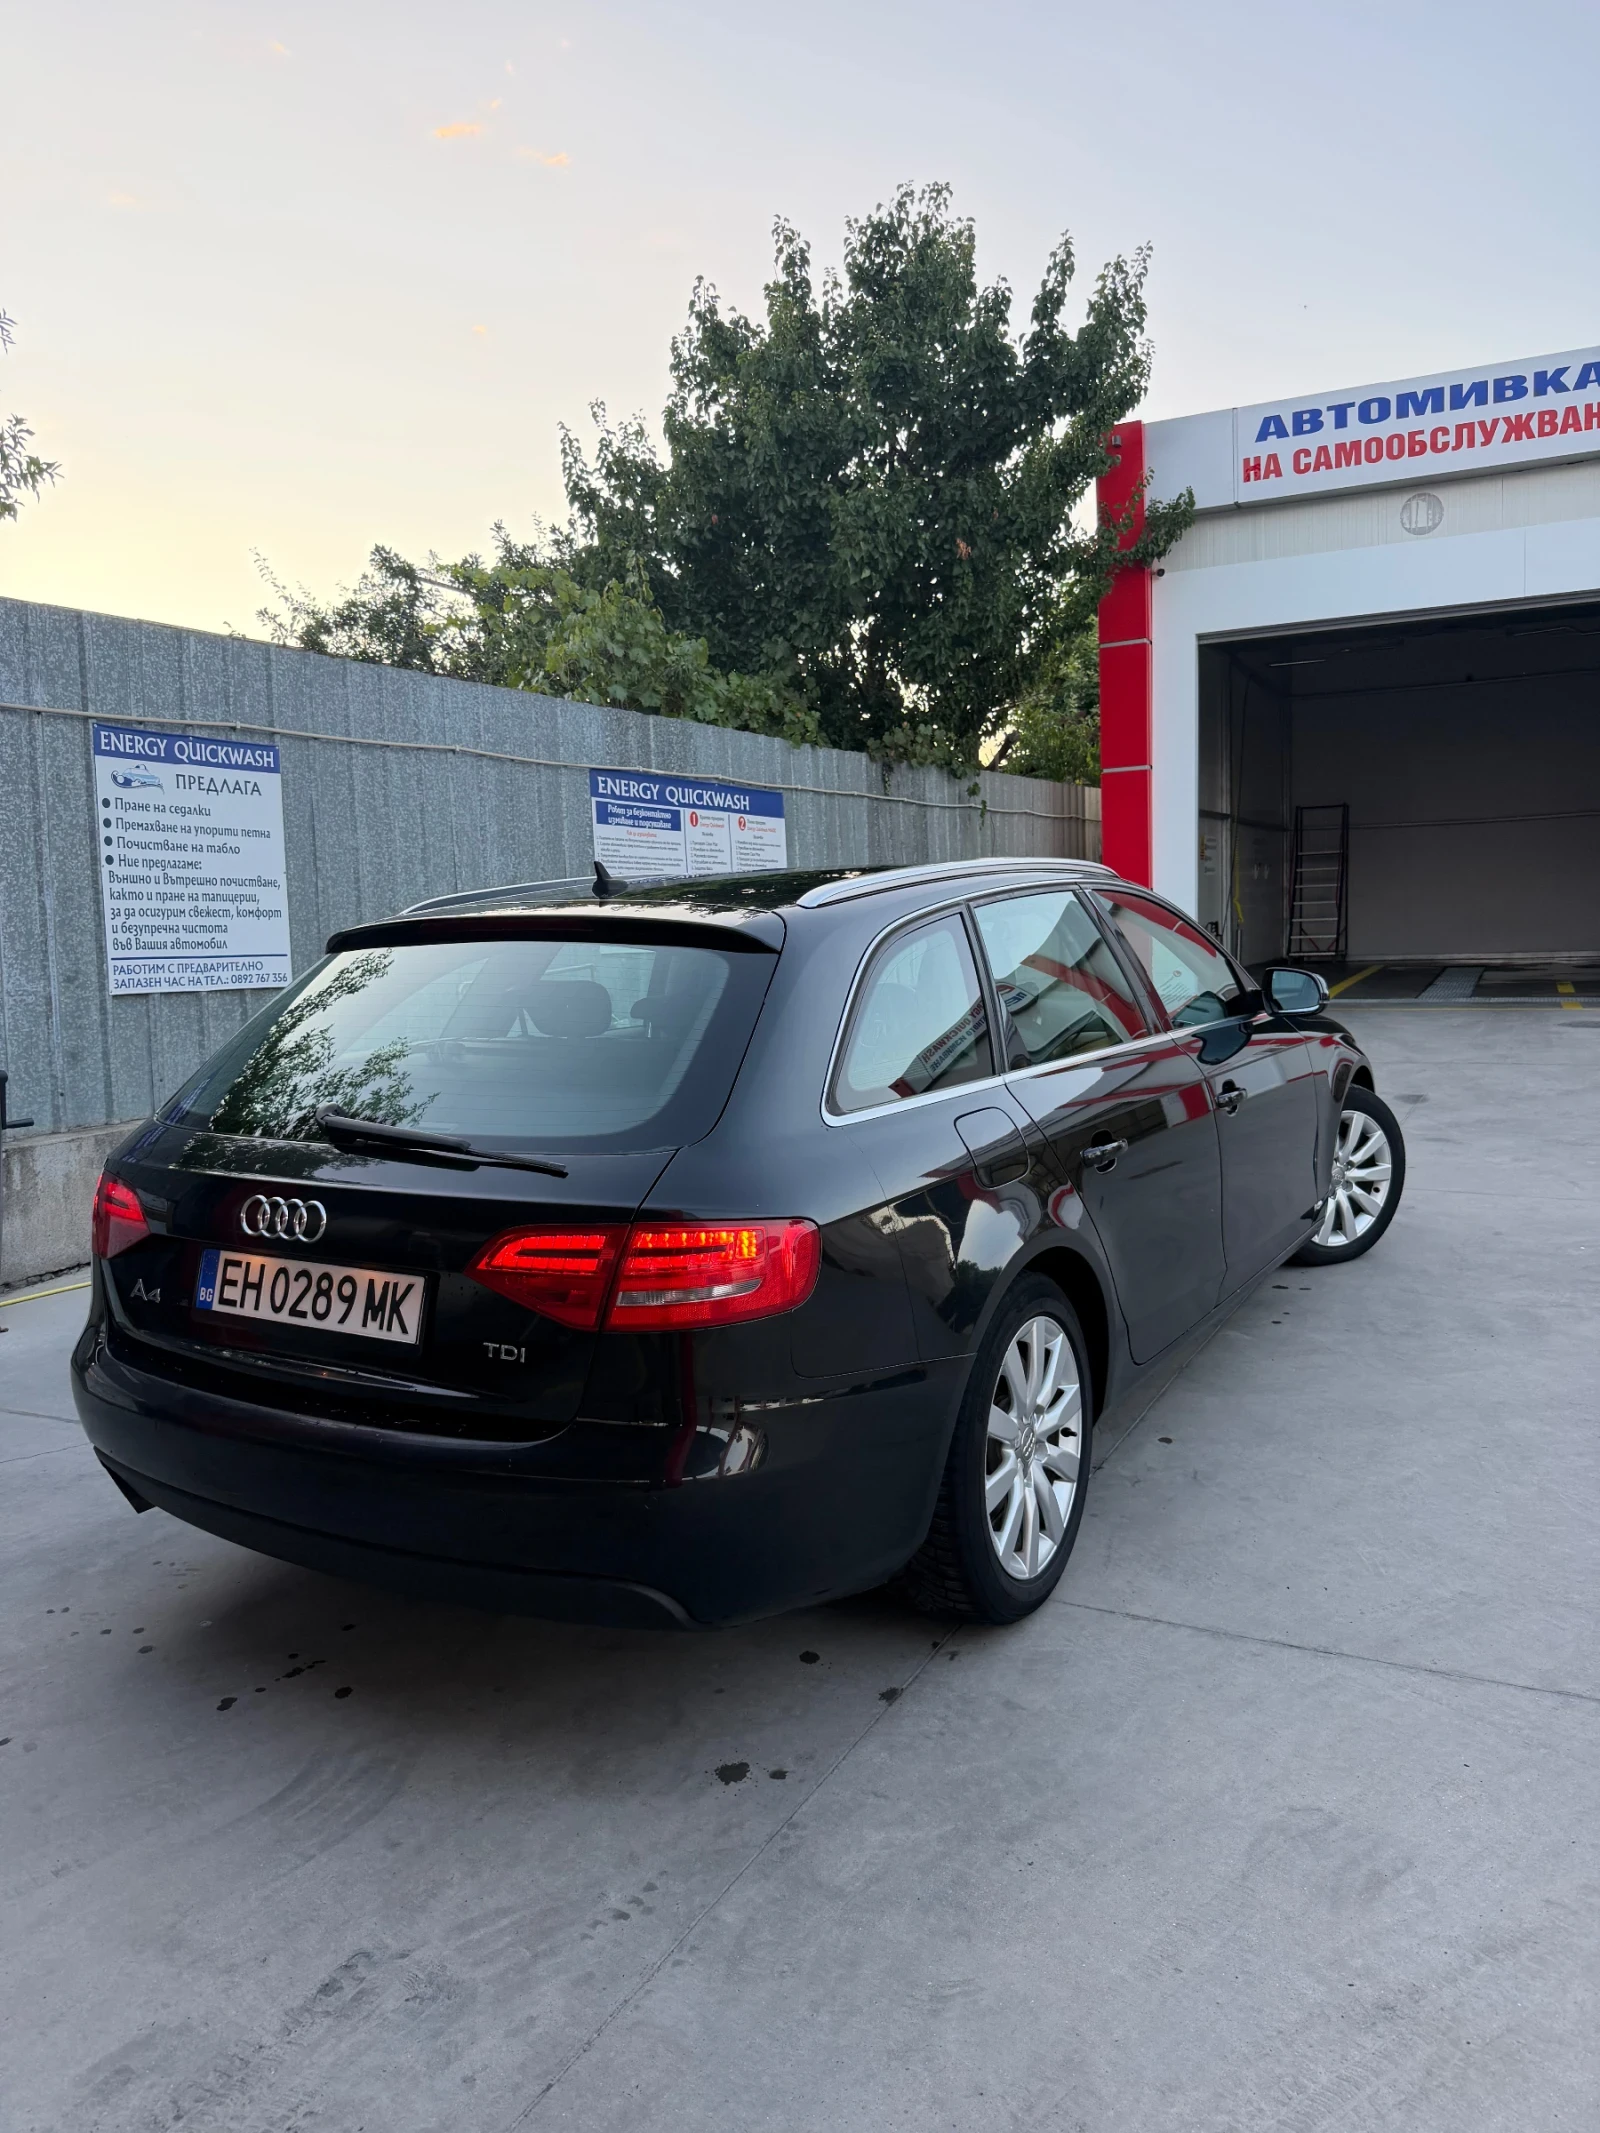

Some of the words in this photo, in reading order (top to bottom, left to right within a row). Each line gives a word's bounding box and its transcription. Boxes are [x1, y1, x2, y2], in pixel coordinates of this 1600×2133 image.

[1255, 362, 1600, 443] АВТОМИВКА
[1243, 452, 1282, 483] НА
[101, 731, 166, 755] ENERGY
[174, 740, 274, 767] QUICKWASH
[176, 774, 261, 796] ПРЕДЛАГА
[597, 776, 659, 800] ENERGY
[666, 787, 749, 810] QUICKWASH
[115, 798, 150, 813] Пране
[153, 803, 166, 813] на
[170, 805, 211, 817] седалки
[116, 817, 177, 834] Премахване
[180, 824, 192, 833] на
[194, 825, 238, 838] упорити
[241, 829, 270, 839] петна
[117, 837, 188, 853] Почистване
[191, 843, 204, 852] на
[207, 841, 240, 854] табло
[118, 855, 139, 867] Ние
[142, 859, 202, 871] предлагаме:
[109, 871, 152, 885] Външно
[154, 876, 160, 884] и
[163, 872, 217, 888] Вътрешно
[220, 875, 281, 890] почистване,
[110, 888, 143, 901] както
[146, 892, 153, 901] и
[156, 892, 185, 903] пране
[188, 892, 199, 901] на
[202, 893, 260, 905] тапицерии,
[111, 908, 121, 920] за
[125, 908, 136, 919] да
[139, 908, 186, 920] осигурим
[188, 905, 234, 920] свежест,
[236, 905, 282, 920] комфорт
[112, 925, 119, 933] и
[121, 922, 180, 936] безупречна
[182, 924, 228, 933] чистота
[113, 939, 132, 951] във
[135, 938, 167, 950] Вашия
[170, 937, 227, 950] автомобил
[113, 964, 165, 975] РАБОТИМ
[168, 964, 174, 974] С
[177, 962, 263, 973] ПРЕДВАРИТЕЛНО
[114, 977, 161, 989] ЗАПАЗЕН
[164, 977, 185, 987] ЧАС
[188, 976, 202, 986] НА
[203, 976, 229, 986] ТЕЛ.:
[231, 974, 253, 985] 0892
[256, 973, 270, 983] 767
[273, 973, 288, 983] 356
[130, 1279, 160, 1304] A4
[199, 1287, 213, 1302] BG
[484, 1342, 526, 1363] TDI
